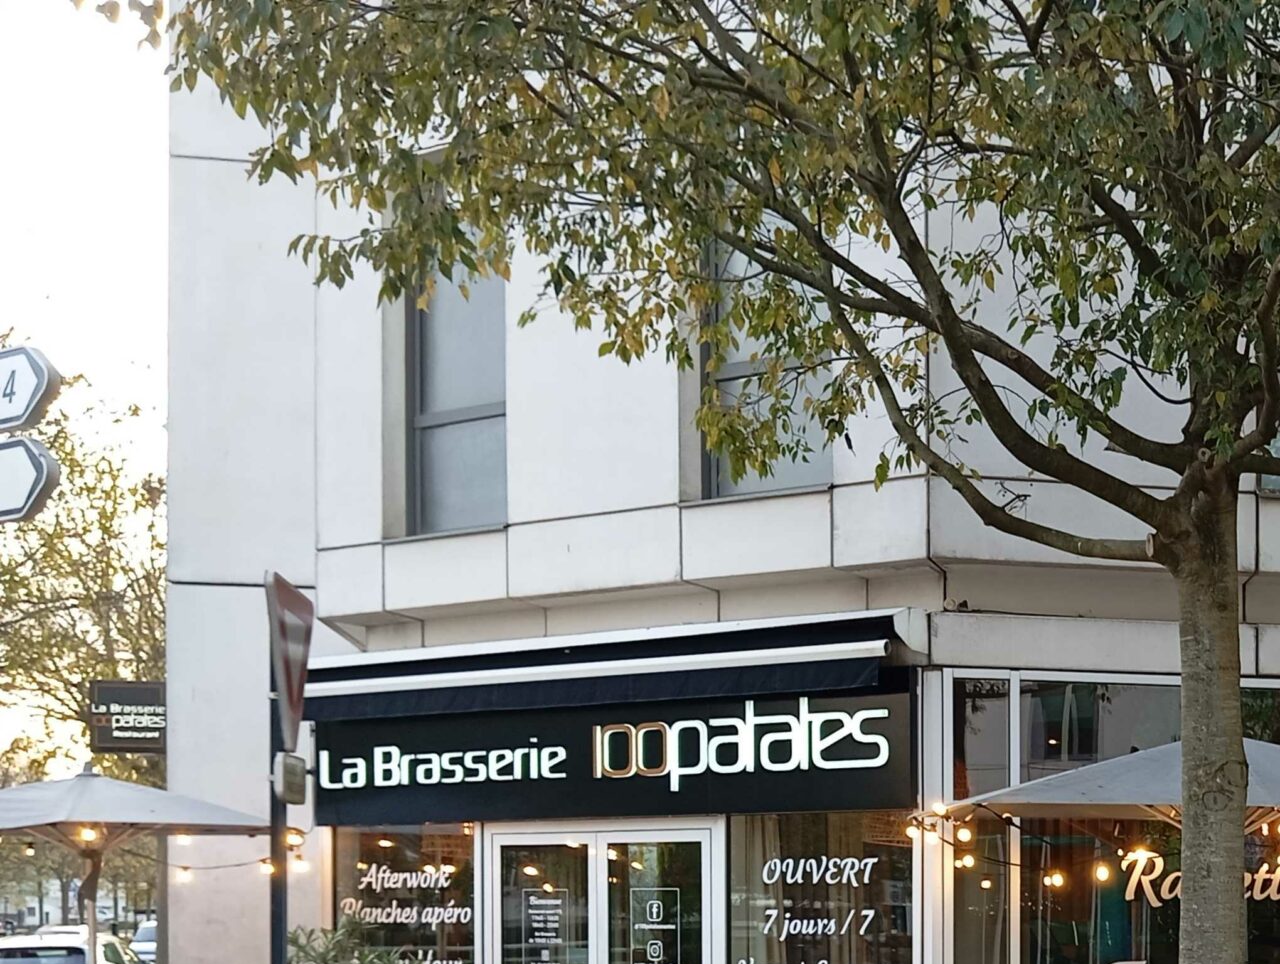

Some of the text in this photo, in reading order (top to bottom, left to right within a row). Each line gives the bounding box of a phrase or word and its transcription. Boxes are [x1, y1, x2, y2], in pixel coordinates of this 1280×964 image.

[2, 370, 17, 404] 4
[91, 703, 166, 714] La Brasserie
[319, 748, 366, 790] La
[373, 737, 567, 787] Brasserie
[358, 862, 451, 893] Afterwork
[762, 856, 879, 887] OUVERT
[340, 897, 472, 931] Planches apéro
[763, 909, 778, 934] 7
[779, 912, 836, 941] jours
[859, 909, 875, 935] 7
